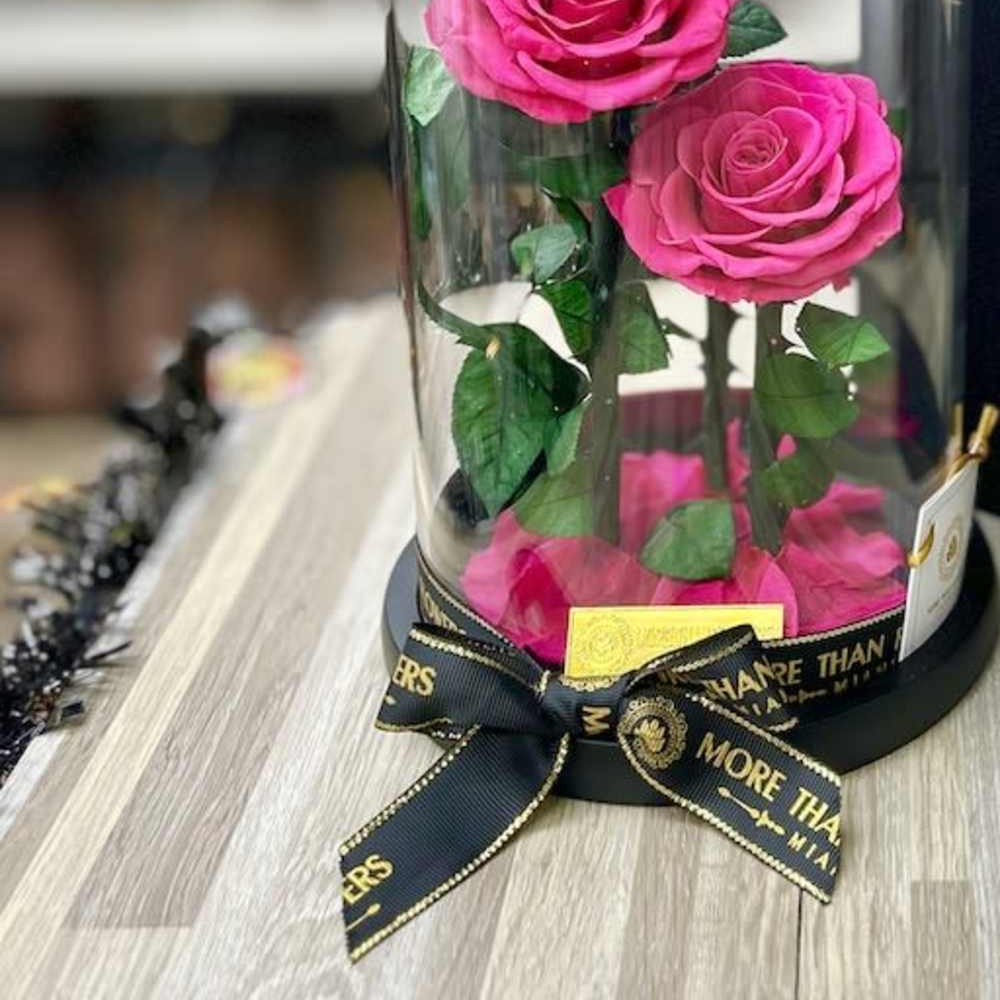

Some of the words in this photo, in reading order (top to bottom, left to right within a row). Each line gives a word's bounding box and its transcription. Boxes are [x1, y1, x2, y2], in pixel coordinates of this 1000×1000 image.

[392, 654, 437, 697] ERS
[817, 634, 886, 679] THAN
[695, 732, 787, 802] MORE
[789, 787, 841, 847] THA
[341, 854, 394, 904] ERS
